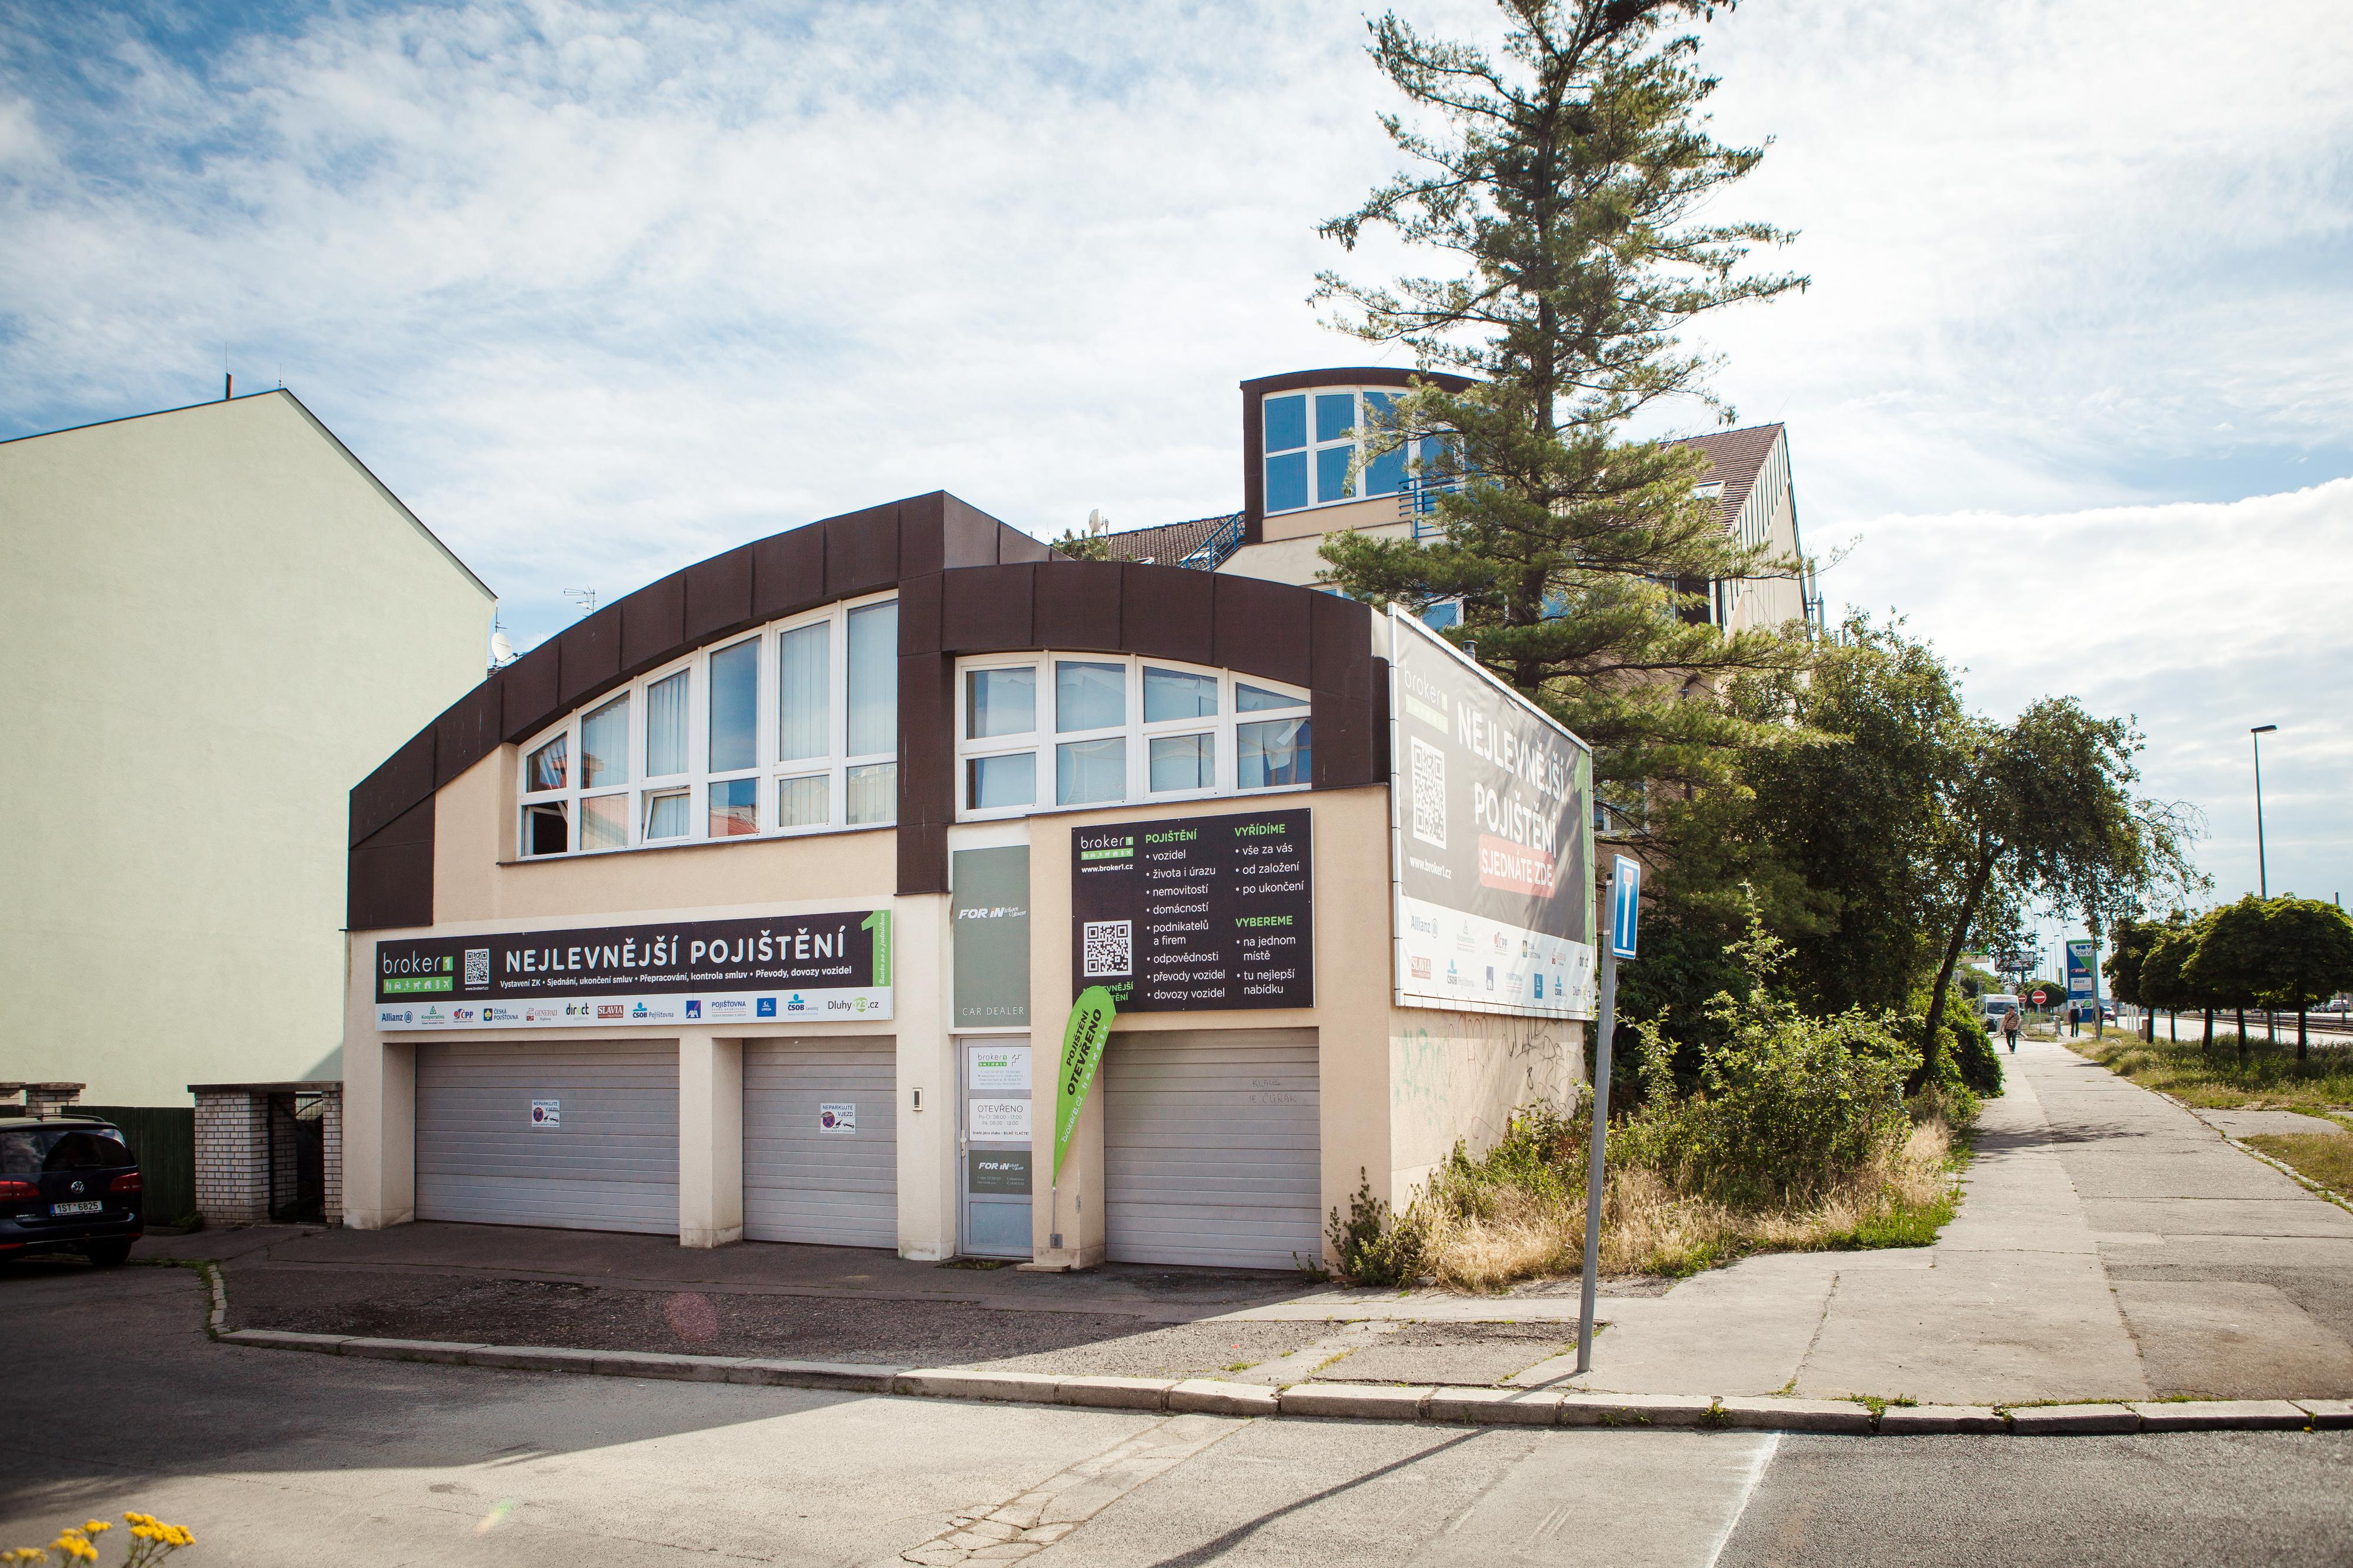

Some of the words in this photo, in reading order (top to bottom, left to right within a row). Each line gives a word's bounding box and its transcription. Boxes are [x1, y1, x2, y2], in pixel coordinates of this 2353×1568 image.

[1457, 700, 1564, 803] NEJLEVNĚJŠÍ
[1474, 782, 1557, 859] POJIŠTĚNÍ
[1146, 828, 1197, 843] POJIŠTĚNÍ
[1235, 823, 1285, 837] VYŘÍDÍME
[1153, 849, 1186, 860] vozidel
[1242, 845, 1259, 855] vše
[1262, 846, 1274, 854] za
[1276, 842, 1293, 853] vás
[1081, 864, 1134, 873] www.broker1.cz
[1153, 868, 1181, 879] života
[1184, 867, 1187, 876] i
[1189, 866, 1216, 876] úrazu
[1242, 865, 1255, 875] od
[1258, 861, 1299, 874] založení
[1409, 856, 1451, 879] www.broker1.cz
[1482, 848, 1532, 883] SJEDNÁTE
[1534, 860, 1552, 886] ZDE
[1153, 884, 1208, 896] nemovitostí
[1243, 885, 1255, 895] po
[1259, 880, 1304, 893] ukončení
[958, 908, 988, 919] FOR
[1153, 902, 1208, 915] domácností
[1153, 920, 1209, 934] podnikatelů
[1235, 915, 1293, 928] VYBEREME
[1411, 916, 1431, 933] Allianz
[1161, 935, 1186, 945] firem
[1244, 938, 1255, 947] na
[1257, 935, 1295, 948] jednom
[506, 935, 679, 973] NEJLEVNĚJŠÍ
[691, 925, 846, 965] POJIŠTĚNÍ
[1244, 950, 1270, 961] místě
[1154, 951, 1218, 965] odpovědnosti
[1412, 958, 1431, 972] SLAVIA
[500, 979, 529, 989] Vystavení
[532, 979, 541, 987] ZK
[547, 977, 578, 987] Sjednání,
[580, 976, 611, 985] ukončení
[612, 975, 633, 983] smluv
[640, 972, 689, 983] Přepracování,
[691, 972, 722, 981] kontrola
[725, 970, 748, 979] smluv
[756, 969, 789, 979] Převody,
[791, 968, 819, 977] dovozy
[821, 966, 852, 975] vozidel
[1154, 971, 1190, 983] převody
[1193, 970, 1225, 980] vozidel
[1244, 971, 1254, 980] tu
[1257, 968, 1295, 982] nejlepší
[1154, 989, 1188, 1001] dovozy
[1191, 988, 1225, 998] vozidel
[1244, 984, 1284, 995] nabídku
[461, 1009, 474, 1019] ČPP
[566, 1003, 589, 1015] direct
[598, 1006, 623, 1015] SLAVIA
[686, 1010, 699, 1018] AXA
[962, 1007, 981, 1016] CAR
[986, 1006, 1024, 1015] DEALER
[382, 1012, 403, 1022] Allianz
[1066, 1008, 1089, 1066] POJIŠTĚNÍ
[1067, 1009, 1102, 1096] OTEVŘENO
[978, 1104, 1023, 1113] OTEVŘENO
[57, 1204, 72, 1212] 1ST
[78, 1202, 99, 1211] 6825
